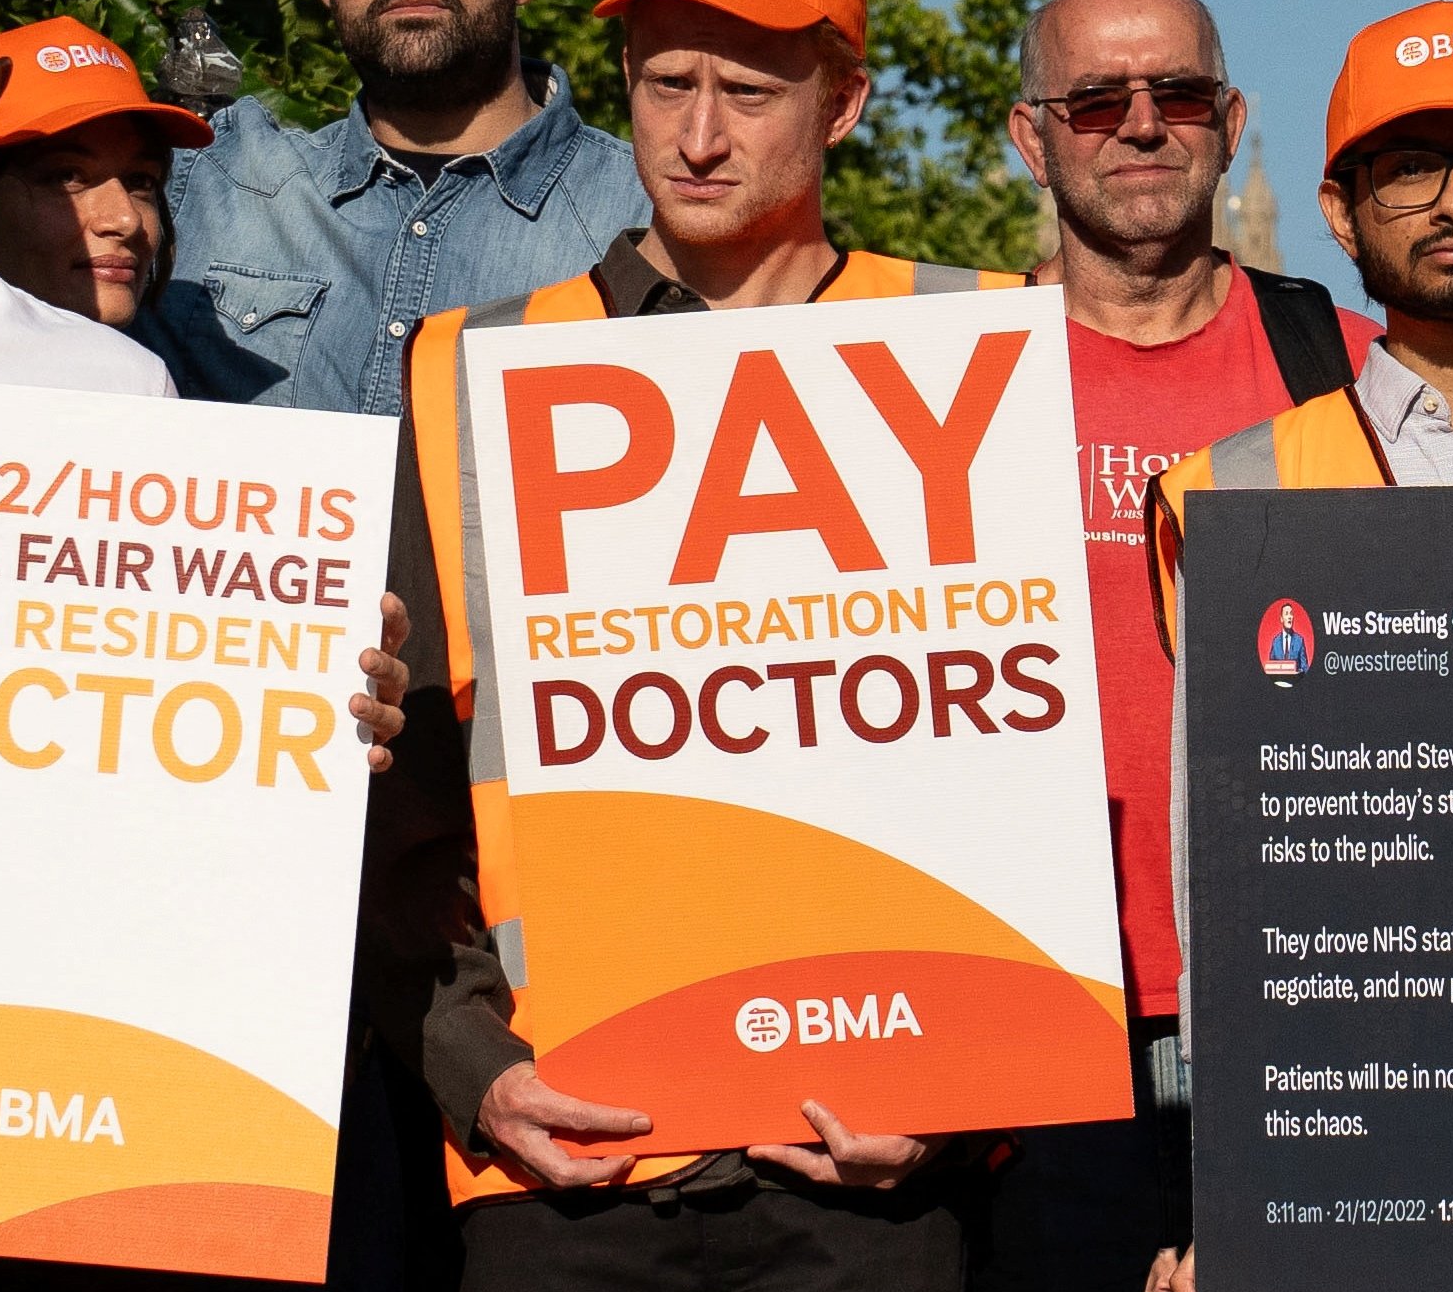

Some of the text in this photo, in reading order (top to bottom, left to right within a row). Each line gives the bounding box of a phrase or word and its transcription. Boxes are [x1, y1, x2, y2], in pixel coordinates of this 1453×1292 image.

[501, 330, 1031, 597] PAY
[298, 488, 356, 541] IS
[1084, 530, 1146, 546] ousingw
[17, 533, 156, 593] FAIR
[173, 546, 350, 608] WAGE
[525, 577, 1058, 660] RESTORATION FOR
[1323, 610, 1448, 639] Wes Streeting
[13, 601, 347, 673] RESIDENT
[1325, 648, 1449, 676] @wesstreeting
[532, 642, 1066, 768] DOCTORS
[1261, 744, 1305, 770] Rishi
[1311, 743, 1371, 770] Sunak
[1377, 742, 1411, 769] and
[1260, 793, 1280, 816] to
[1286, 791, 1358, 822] prevent
[1262, 834, 1433, 867] risks to the public.
[1262, 927, 1309, 960] They
[1315, 926, 1368, 953] drove
[1374, 926, 1416, 952] NHS
[1264, 972, 1358, 1005] negotiate,
[1364, 971, 1399, 998] and
[1405, 978, 1444, 997] now
[797, 991, 923, 1044] BMA
[1266, 1064, 1343, 1090] Patients
[1348, 1063, 1378, 1089] will
[1385, 1063, 1408, 1089] be
[1413, 1063, 1429, 1088] in
[1265, 1109, 1367, 1136] this chaos.
[1336, 1199, 1425, 1225] 21/12/2022
